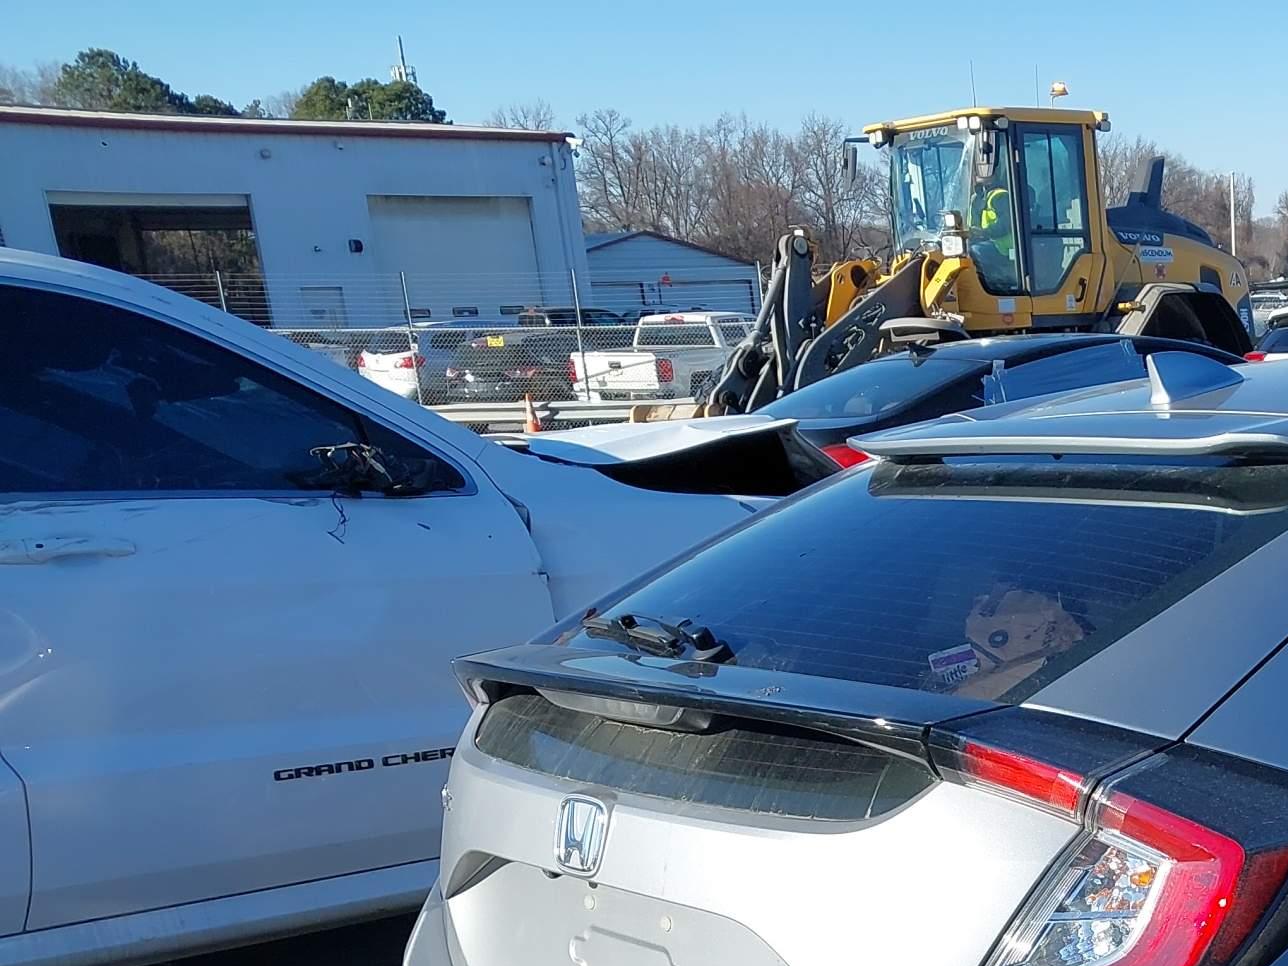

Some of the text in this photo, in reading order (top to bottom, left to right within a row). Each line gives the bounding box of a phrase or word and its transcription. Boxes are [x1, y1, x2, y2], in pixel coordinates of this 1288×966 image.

[910, 127, 948, 140] VOLVO
[1119, 231, 1160, 242] VOVO
[274, 758, 375, 782] GRAND
